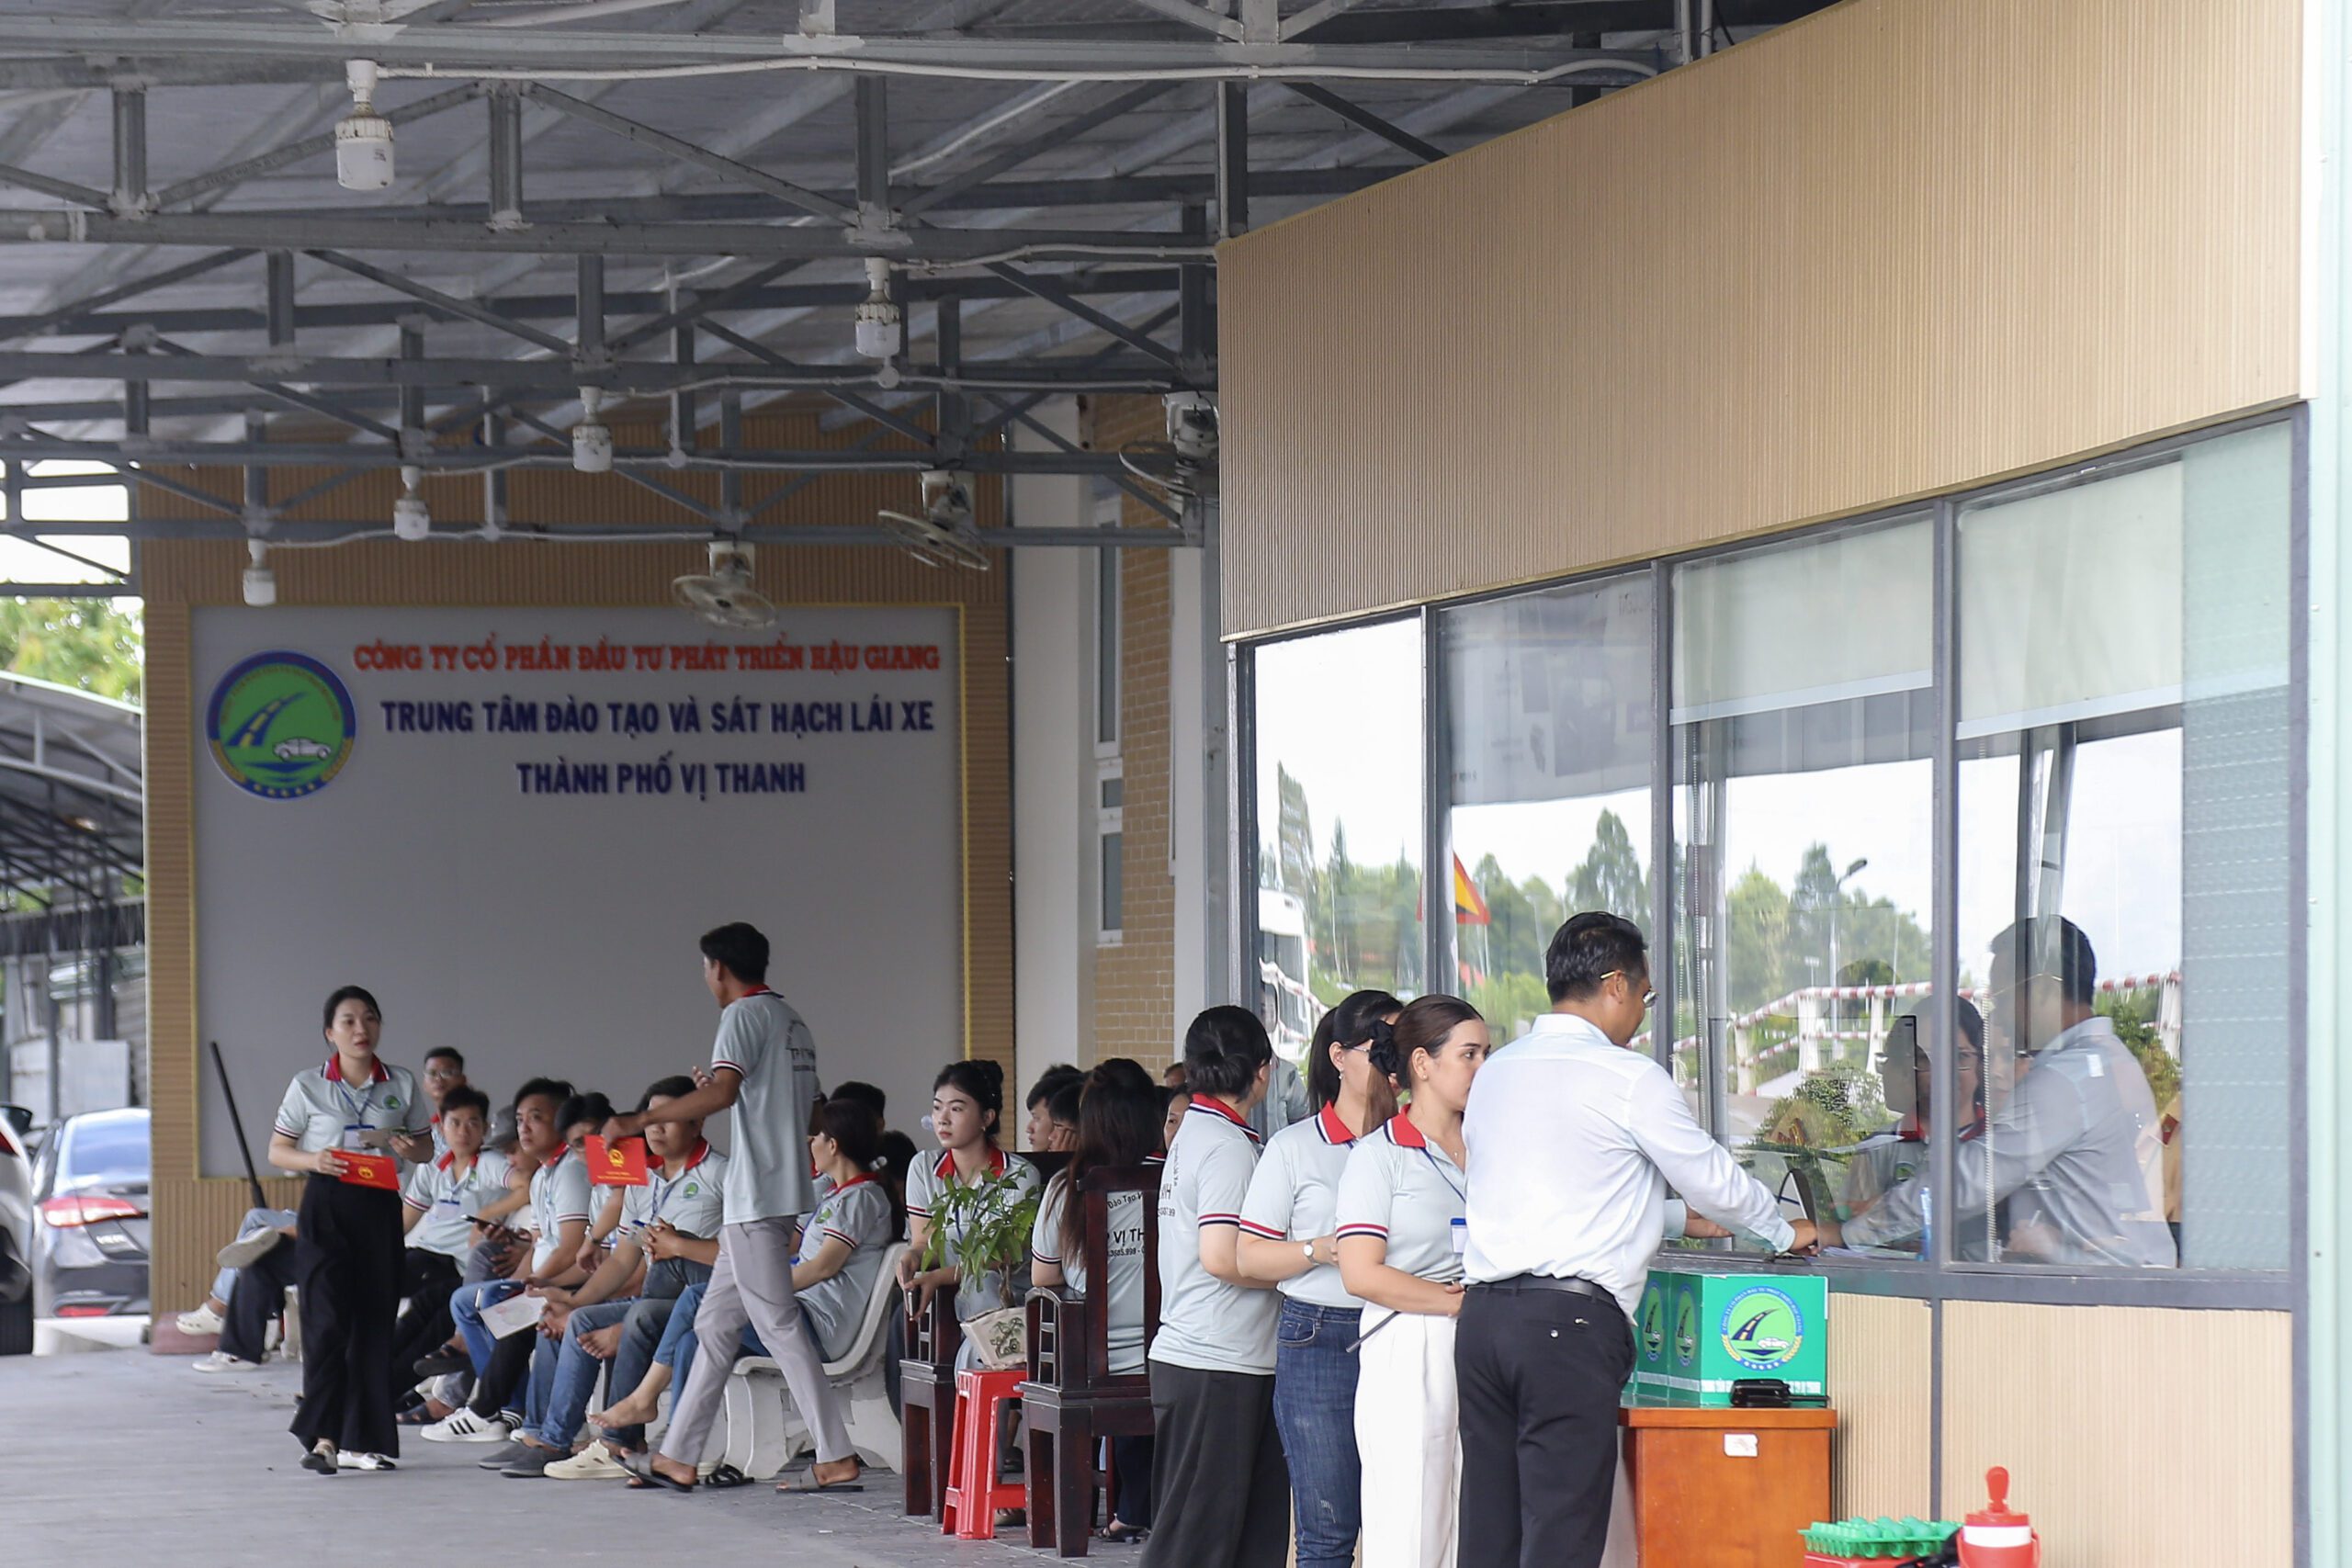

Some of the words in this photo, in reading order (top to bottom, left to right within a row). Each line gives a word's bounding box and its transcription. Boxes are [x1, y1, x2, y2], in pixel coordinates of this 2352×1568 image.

[353, 638, 423, 671] CÔNG
[429, 645, 459, 671] TY
[461, 632, 497, 671] CỔ
[632, 644, 663, 671] TƯ
[669, 640, 729, 671] PHÁT
[734, 631, 803, 671] TRIỂN
[809, 639, 859, 675] HẬU
[864, 645, 941, 671] GIANG
[379, 700, 474, 732] TRUNG
[481, 694, 537, 732] TÂM
[544, 694, 598, 732] ĐÀO
[606, 701, 659, 739] TẠO
[668, 695, 701, 732] VÀ
[710, 695, 761, 732] SÁT
[771, 701, 842, 739] HẠCH
[850, 694, 892, 731] LÁI
[901, 700, 933, 731] XE
[515, 756, 608, 794] THÀNH
[616, 750, 673, 794] PHỐ
[680, 763, 707, 801] VỊ
[714, 763, 805, 793] THANH
